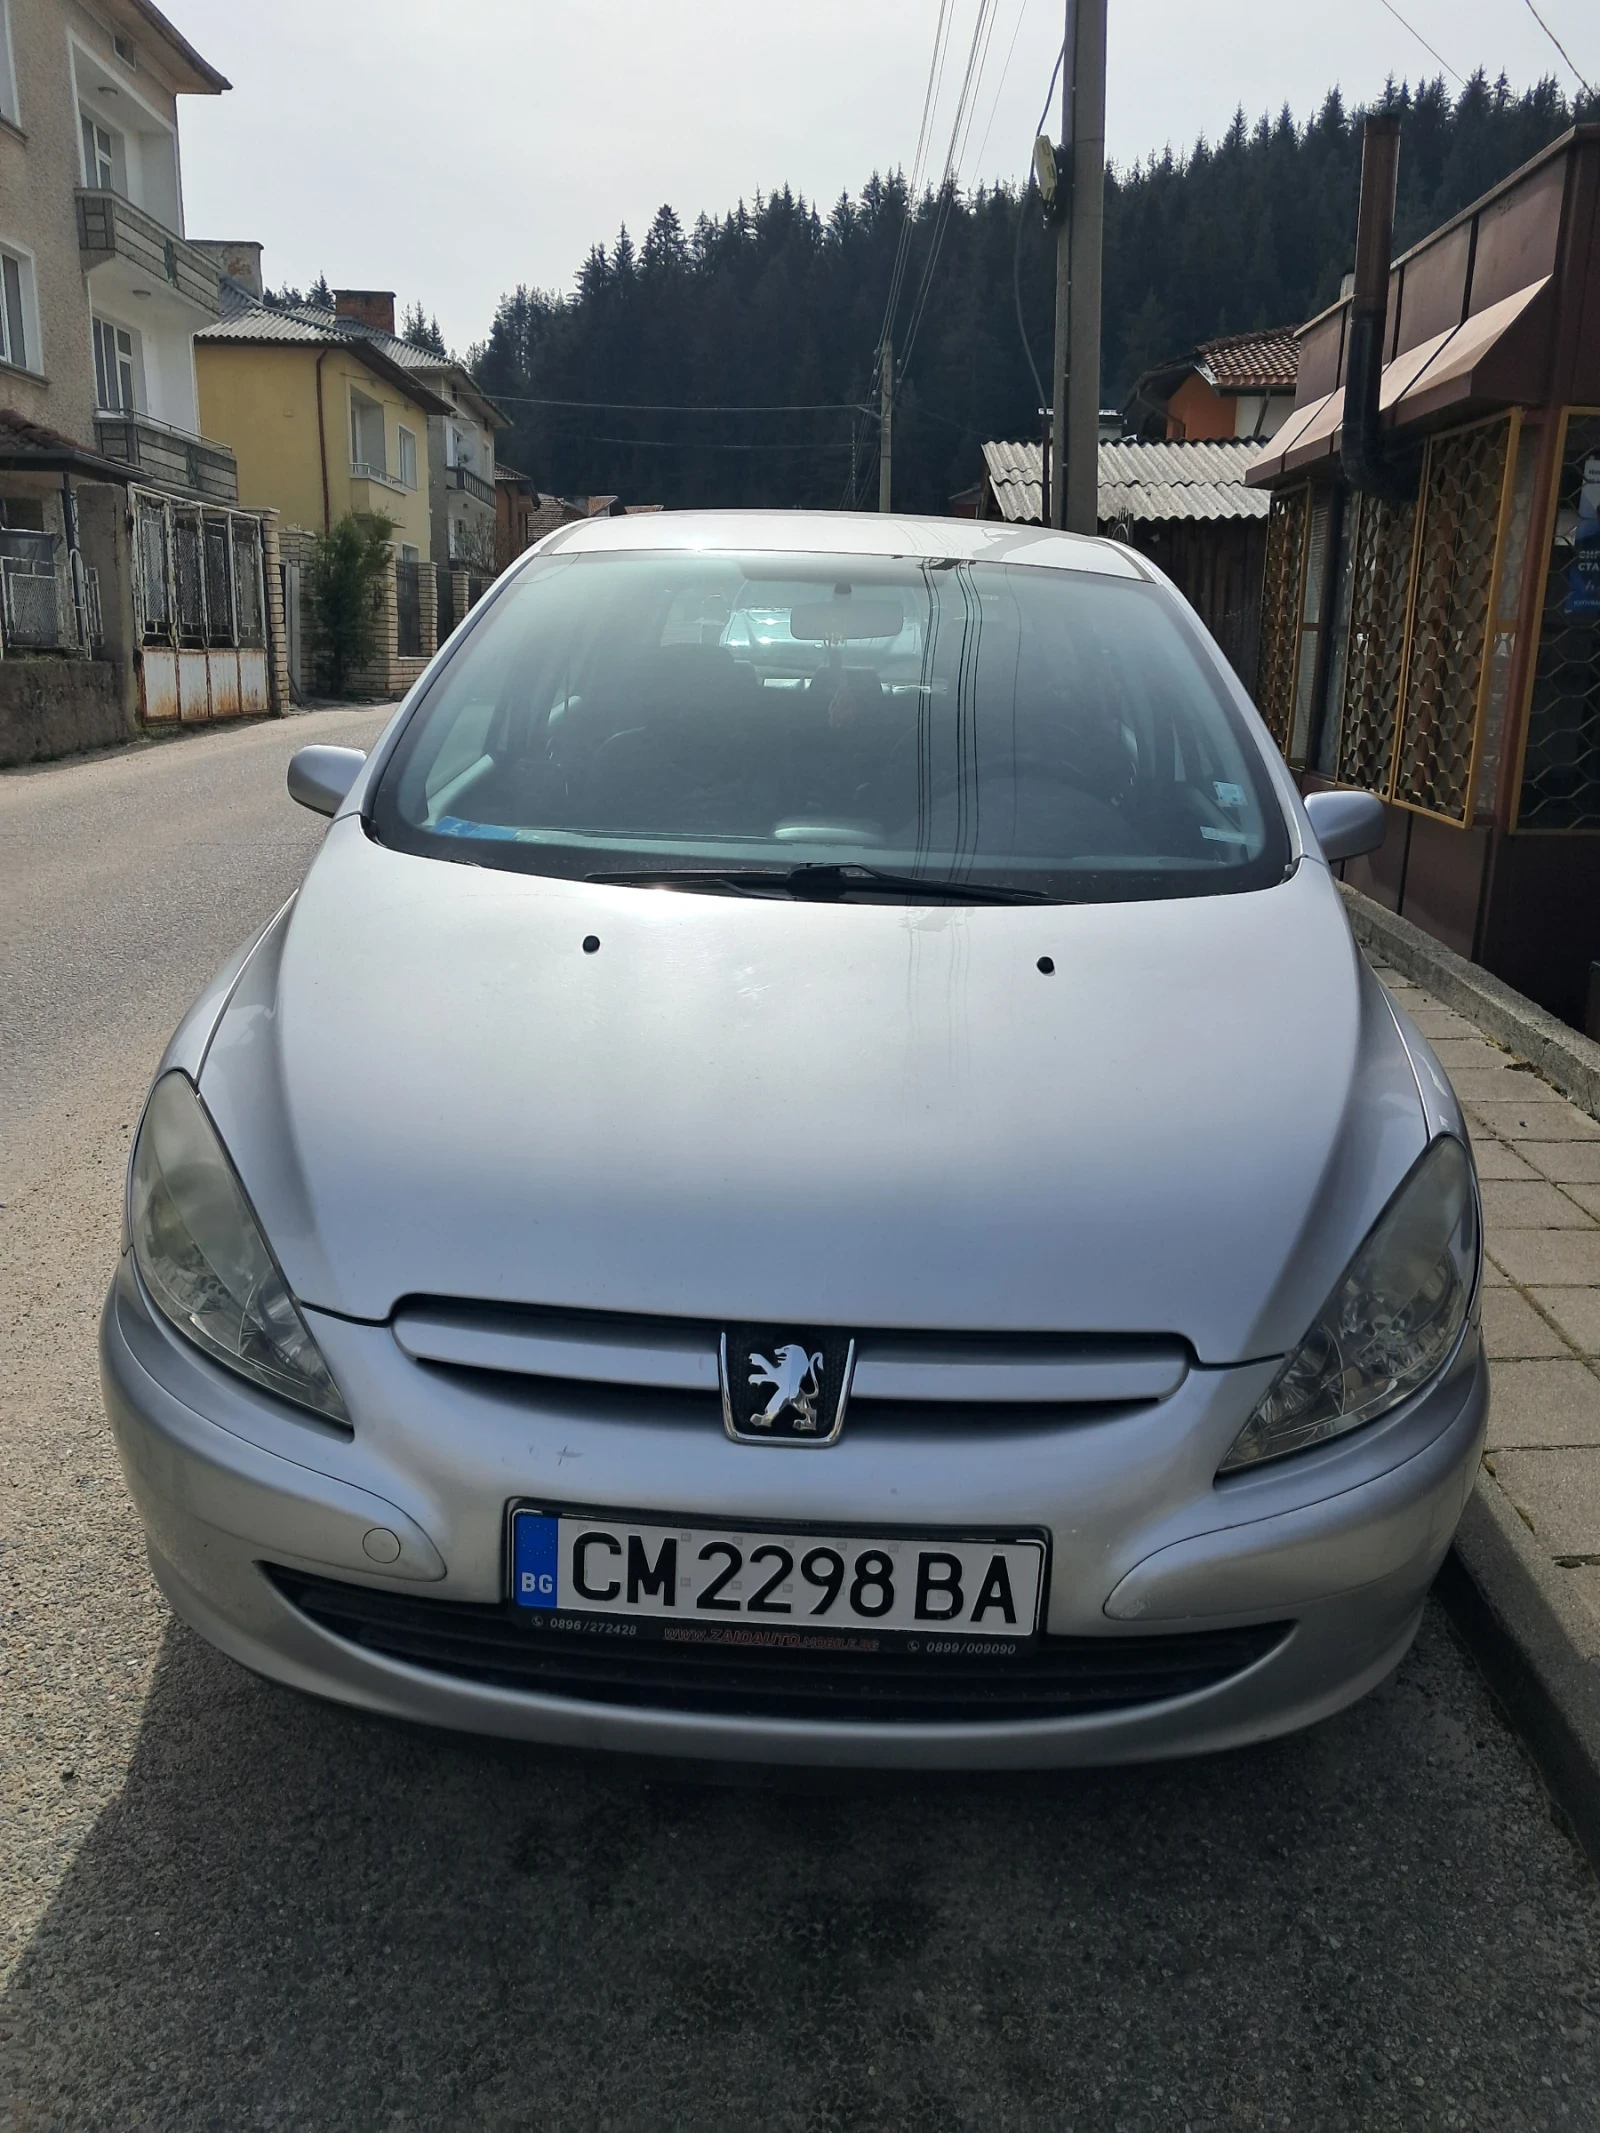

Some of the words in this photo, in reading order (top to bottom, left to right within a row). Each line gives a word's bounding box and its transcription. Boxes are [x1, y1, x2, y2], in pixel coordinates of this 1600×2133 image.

[521, 1571, 553, 1594] BG
[572, 1531, 677, 1606] CM
[696, 1541, 895, 1618] 2298
[914, 1551, 1017, 1624] BA
[926, 1641, 1017, 1656] 0899/009090
